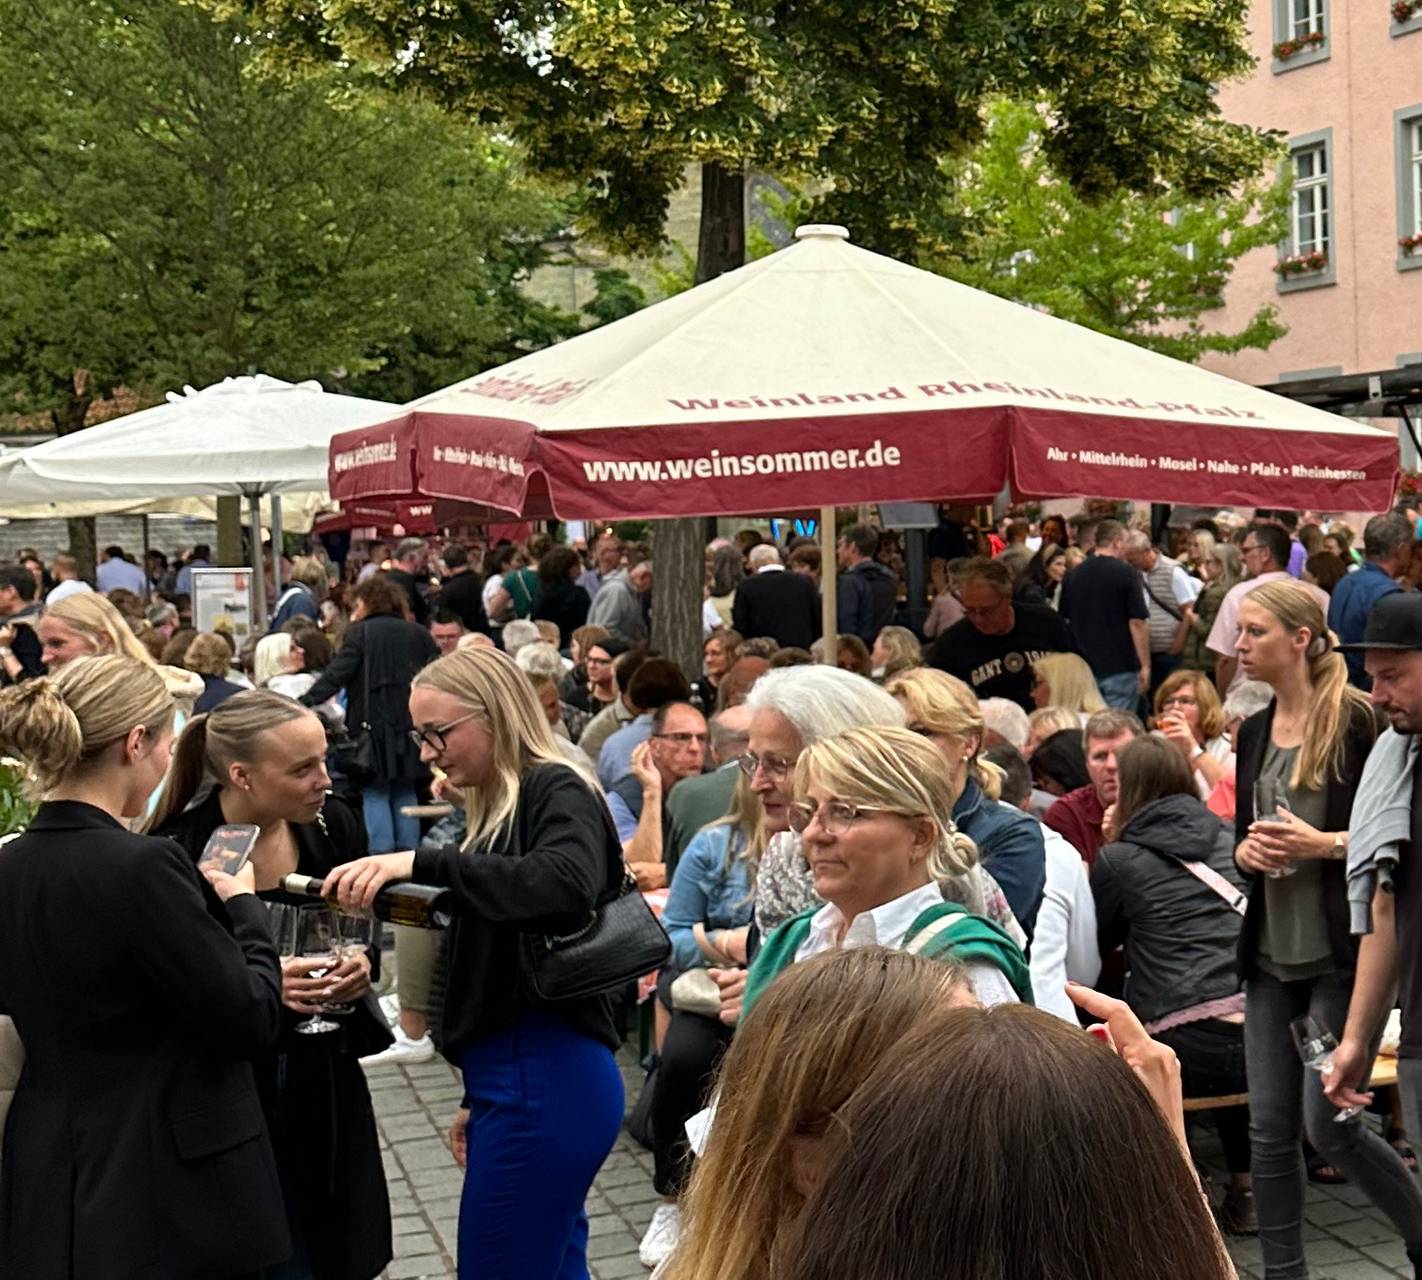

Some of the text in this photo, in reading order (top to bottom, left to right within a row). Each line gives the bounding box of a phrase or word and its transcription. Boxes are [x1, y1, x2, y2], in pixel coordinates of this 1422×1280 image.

[667, 379, 1265, 420] Weinland Rheinland-Pfalz
[582, 439, 901, 482] www.weinsommer.de
[1046, 447, 1367, 480] Ahr Mittelrhein Mosel Nahe Pfalz Rheinhessen
[971, 658, 1002, 686] GANT
